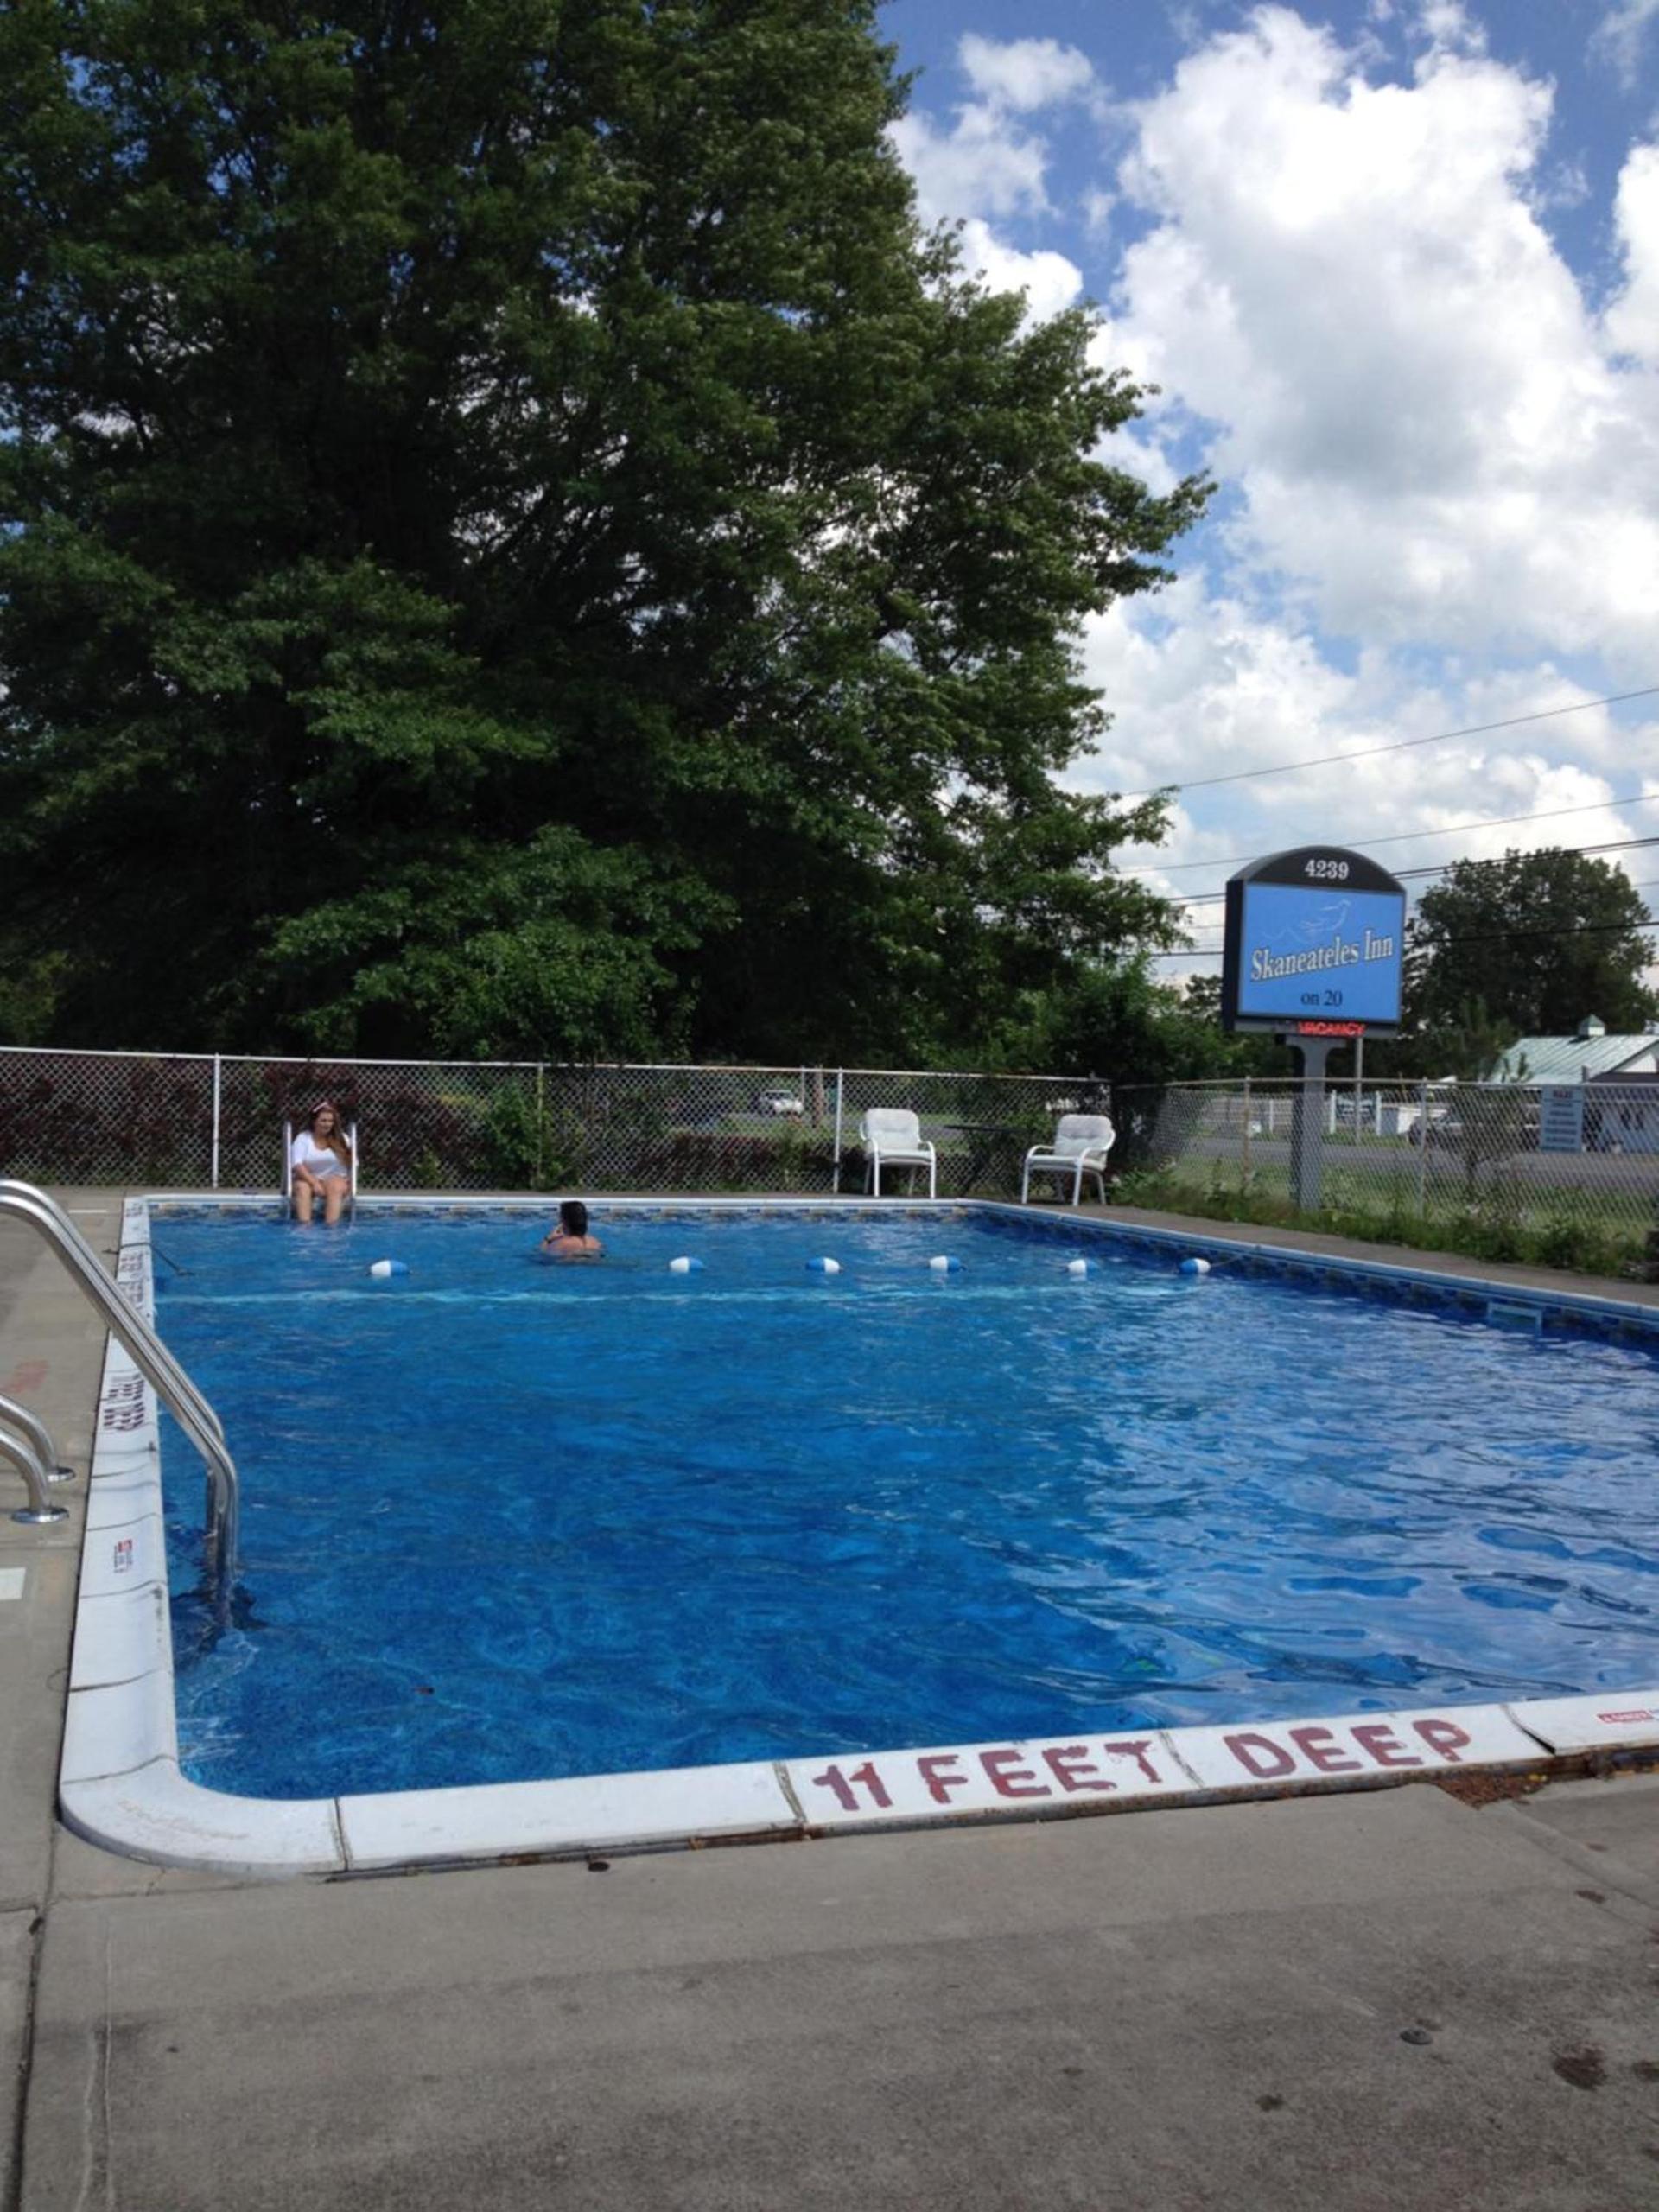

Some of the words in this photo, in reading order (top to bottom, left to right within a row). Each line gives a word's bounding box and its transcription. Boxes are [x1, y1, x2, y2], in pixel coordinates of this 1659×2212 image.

[1305, 859, 1350, 879] 4239
[1250, 936, 1360, 982] Skaneateles
[1364, 930, 1394, 961] Inn
[1301, 994, 1320, 1006] on
[1324, 990, 1344, 1007] 20
[812, 1760, 894, 1812] 11
[916, 1739, 1162, 1804] FEET
[1223, 1719, 1471, 1779] DEEP
